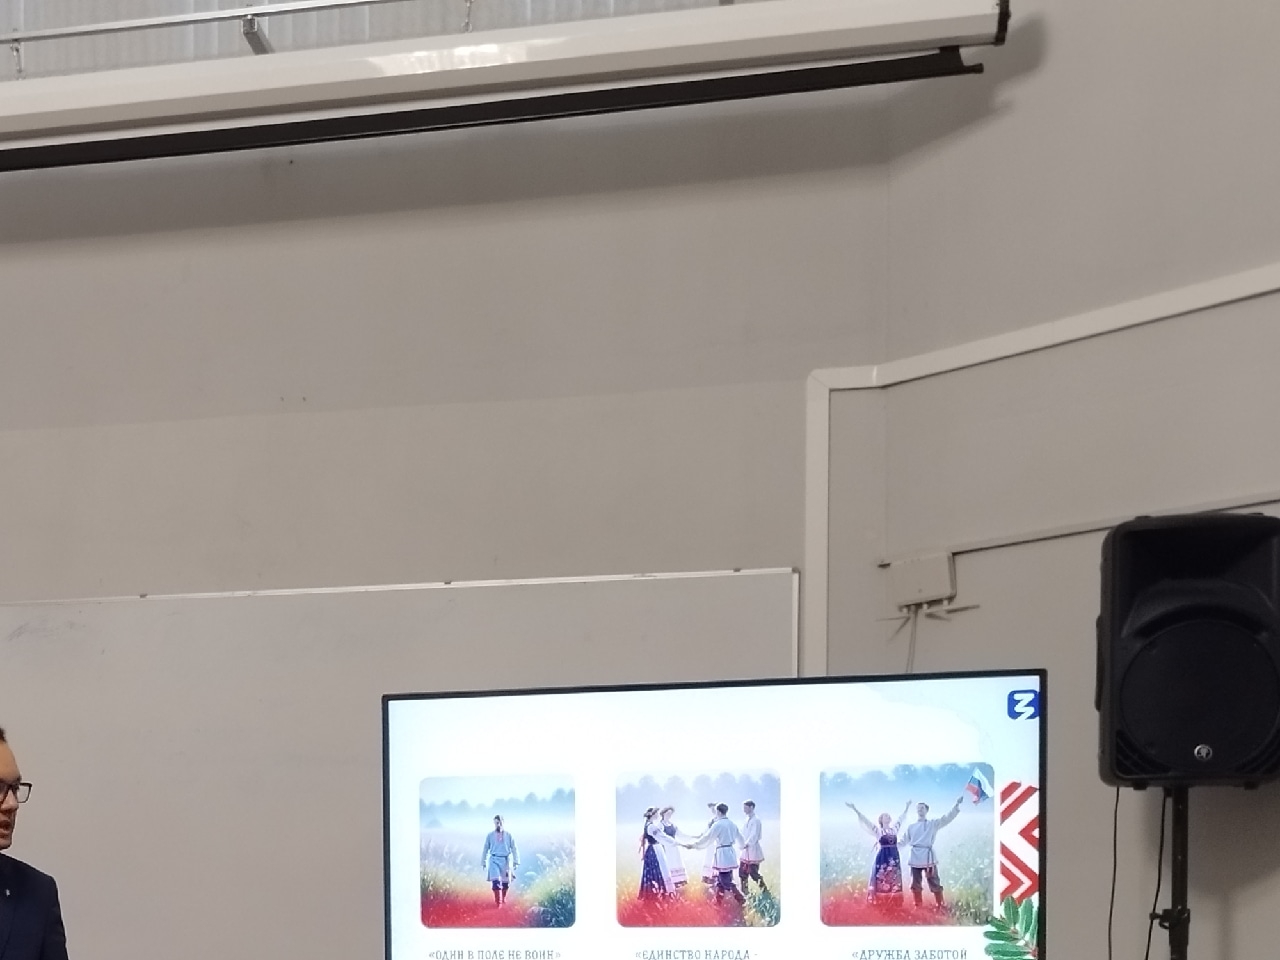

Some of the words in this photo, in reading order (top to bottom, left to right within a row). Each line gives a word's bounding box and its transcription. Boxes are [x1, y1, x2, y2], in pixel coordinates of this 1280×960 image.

[468, 949, 474, 960] В
[508, 949, 522, 960] НЕ
[705, 949, 750, 960] НАРОДА
[914, 948, 967, 960] ЗАБОТОЙ
